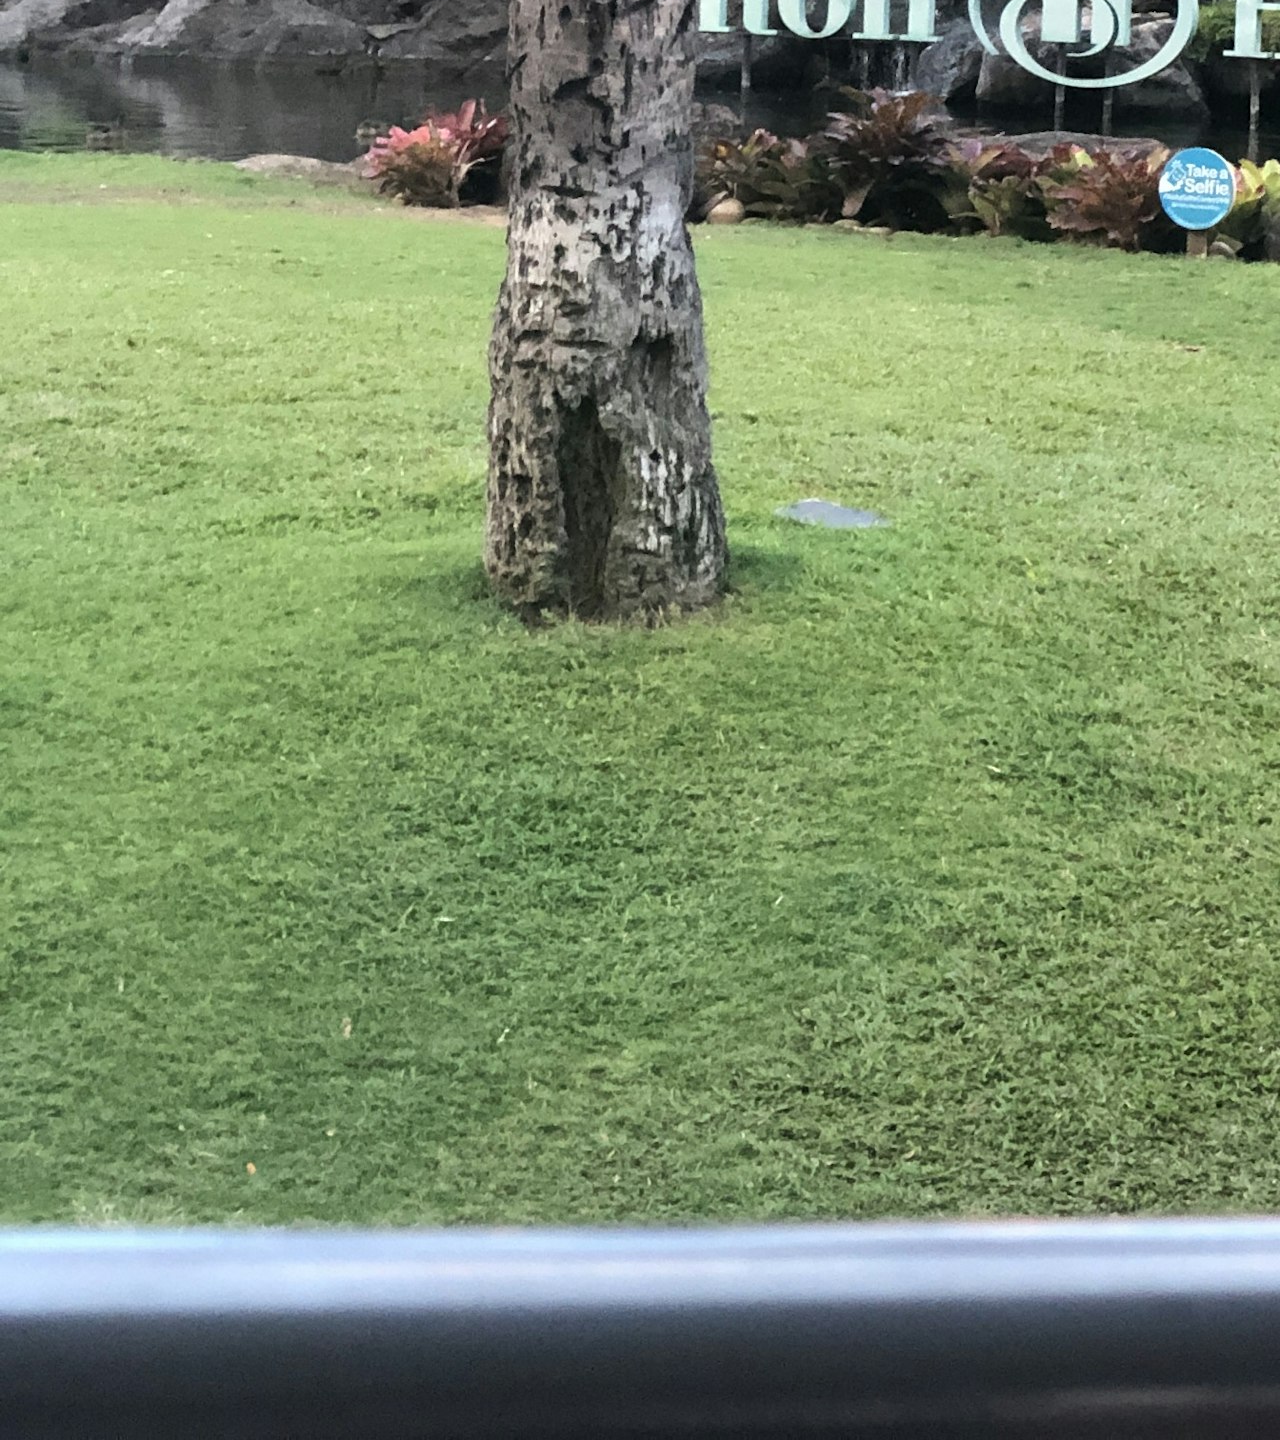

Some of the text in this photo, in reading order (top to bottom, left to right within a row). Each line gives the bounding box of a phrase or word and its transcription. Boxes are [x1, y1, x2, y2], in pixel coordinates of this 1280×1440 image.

[1186, 163, 1229, 179] Take a
[1184, 178, 1230, 195] Selfie
